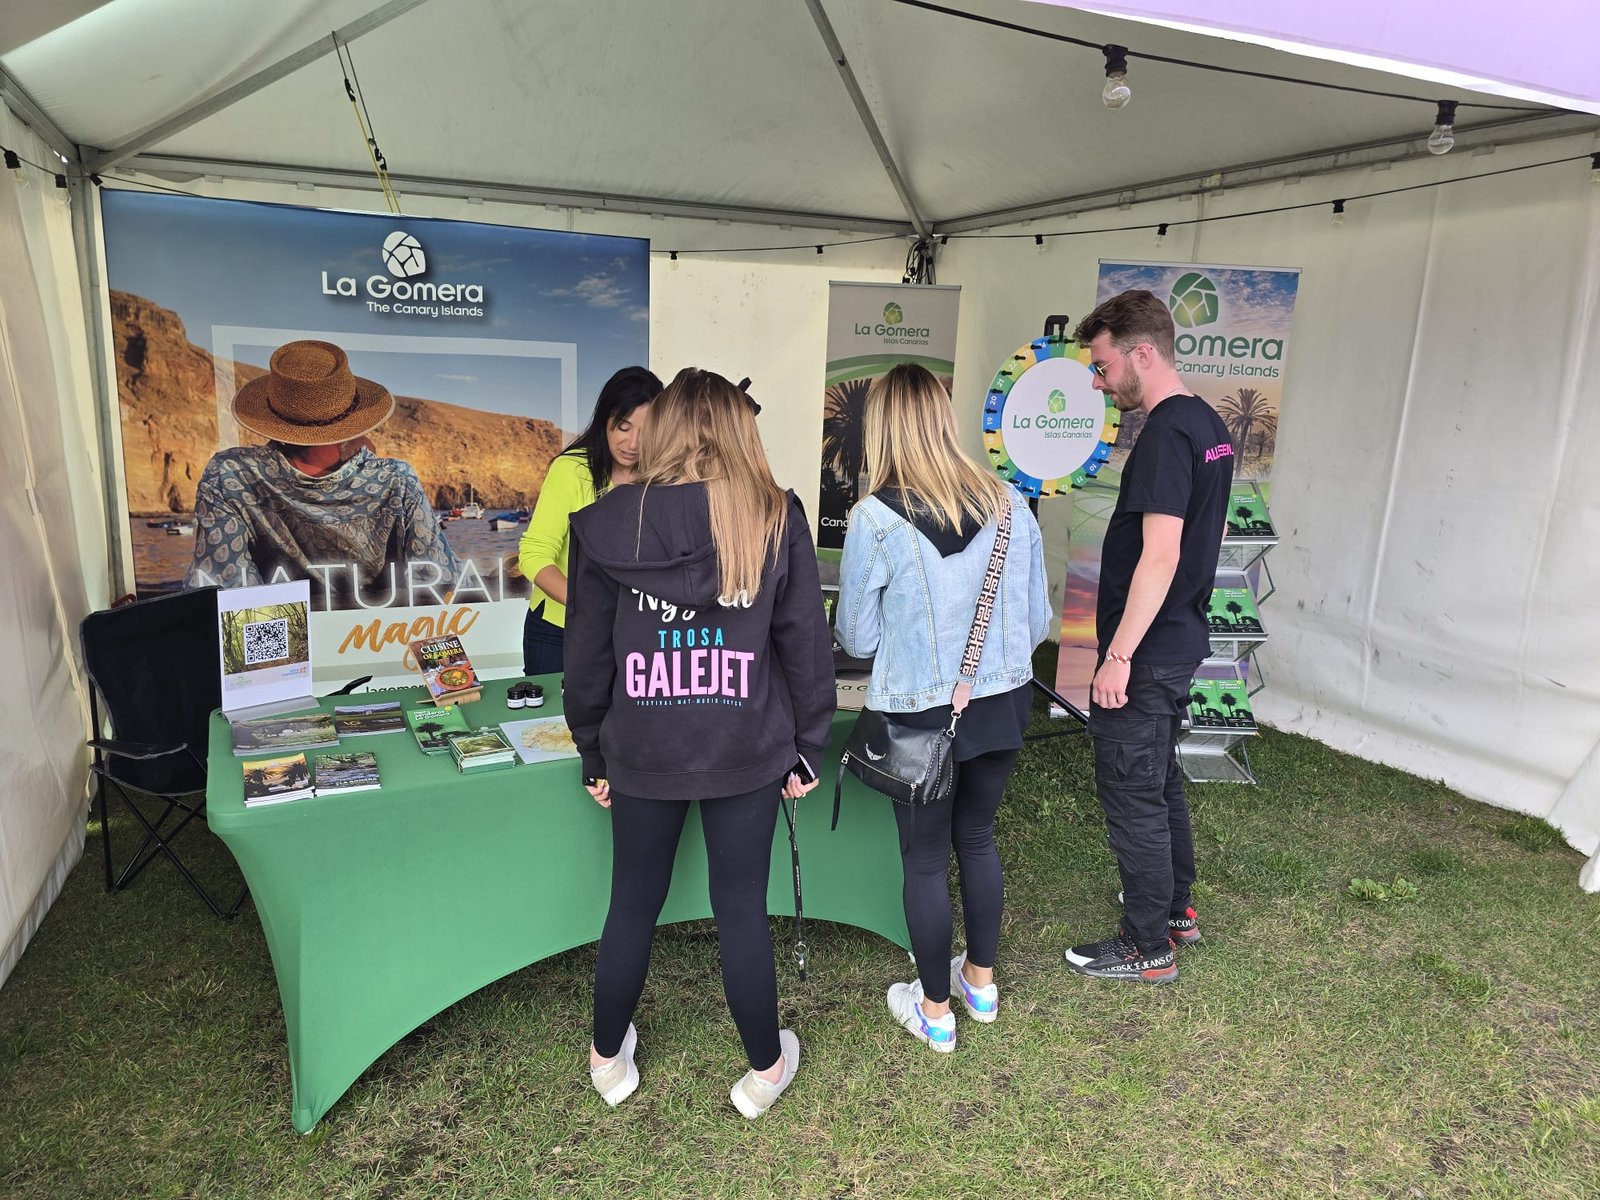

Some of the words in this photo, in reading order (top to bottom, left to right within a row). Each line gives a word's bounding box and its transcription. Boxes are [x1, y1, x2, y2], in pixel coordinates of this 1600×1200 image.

[321, 271, 357, 296] La
[366, 275, 484, 303] Gomera
[367, 301, 390, 313] The
[393, 303, 439, 318] Canary
[441, 305, 484, 317] Islands
[855, 323, 870, 335] La
[875, 324, 930, 337] Gomera
[900, 338, 929, 346] Canarias
[1175, 333, 1284, 360] omera
[1175, 360, 1225, 377] Canary
[1229, 363, 1279, 378] Islands
[996, 379, 1005, 387] 21
[989, 395, 997, 406] 20
[986, 417, 993, 425] 19
[1013, 415, 1030, 429] La
[1036, 415, 1095, 429] Gomera
[1089, 463, 1097, 471] 10
[338, 591, 480, 671] magic
[658, 628, 724, 649] TROSA
[420, 640, 461, 654] CUISINE
[626, 649, 755, 699] GALEJET
[1141, 957, 1166, 970] JEANS
